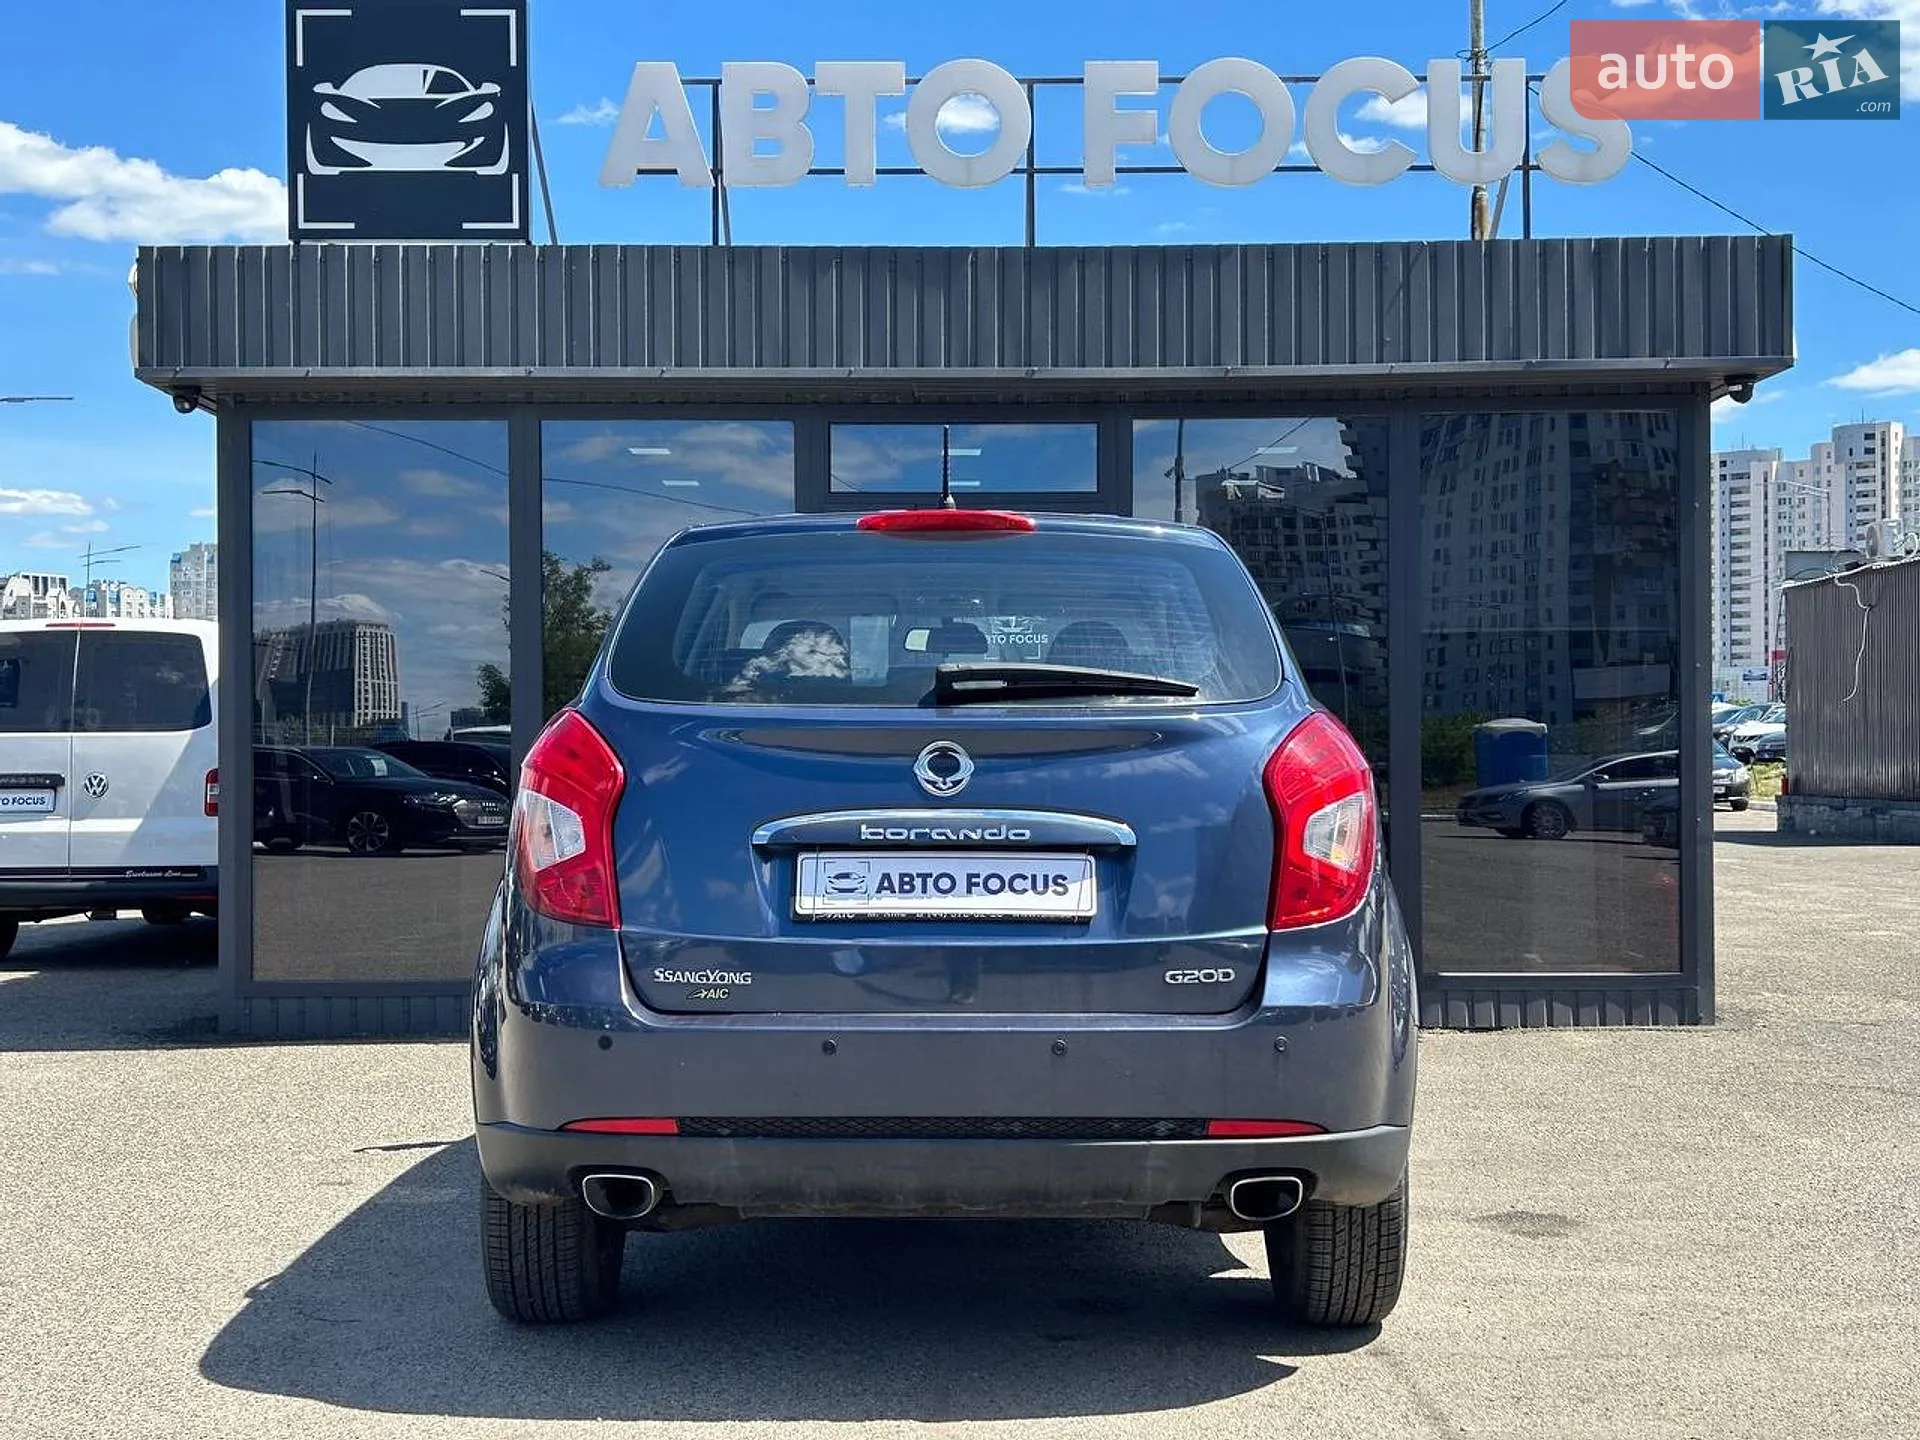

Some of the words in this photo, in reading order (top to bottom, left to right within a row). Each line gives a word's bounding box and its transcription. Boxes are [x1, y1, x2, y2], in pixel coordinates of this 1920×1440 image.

[599, 58, 1032, 188] АВТО
[1083, 56, 1634, 187] FOCUS
[1009, 634, 1048, 644] FOCUS
[12, 796, 46, 805] FOCUS
[875, 872, 957, 895] АВТО
[966, 873, 1069, 896] FOCUS
[1165, 968, 1236, 984] G20D
